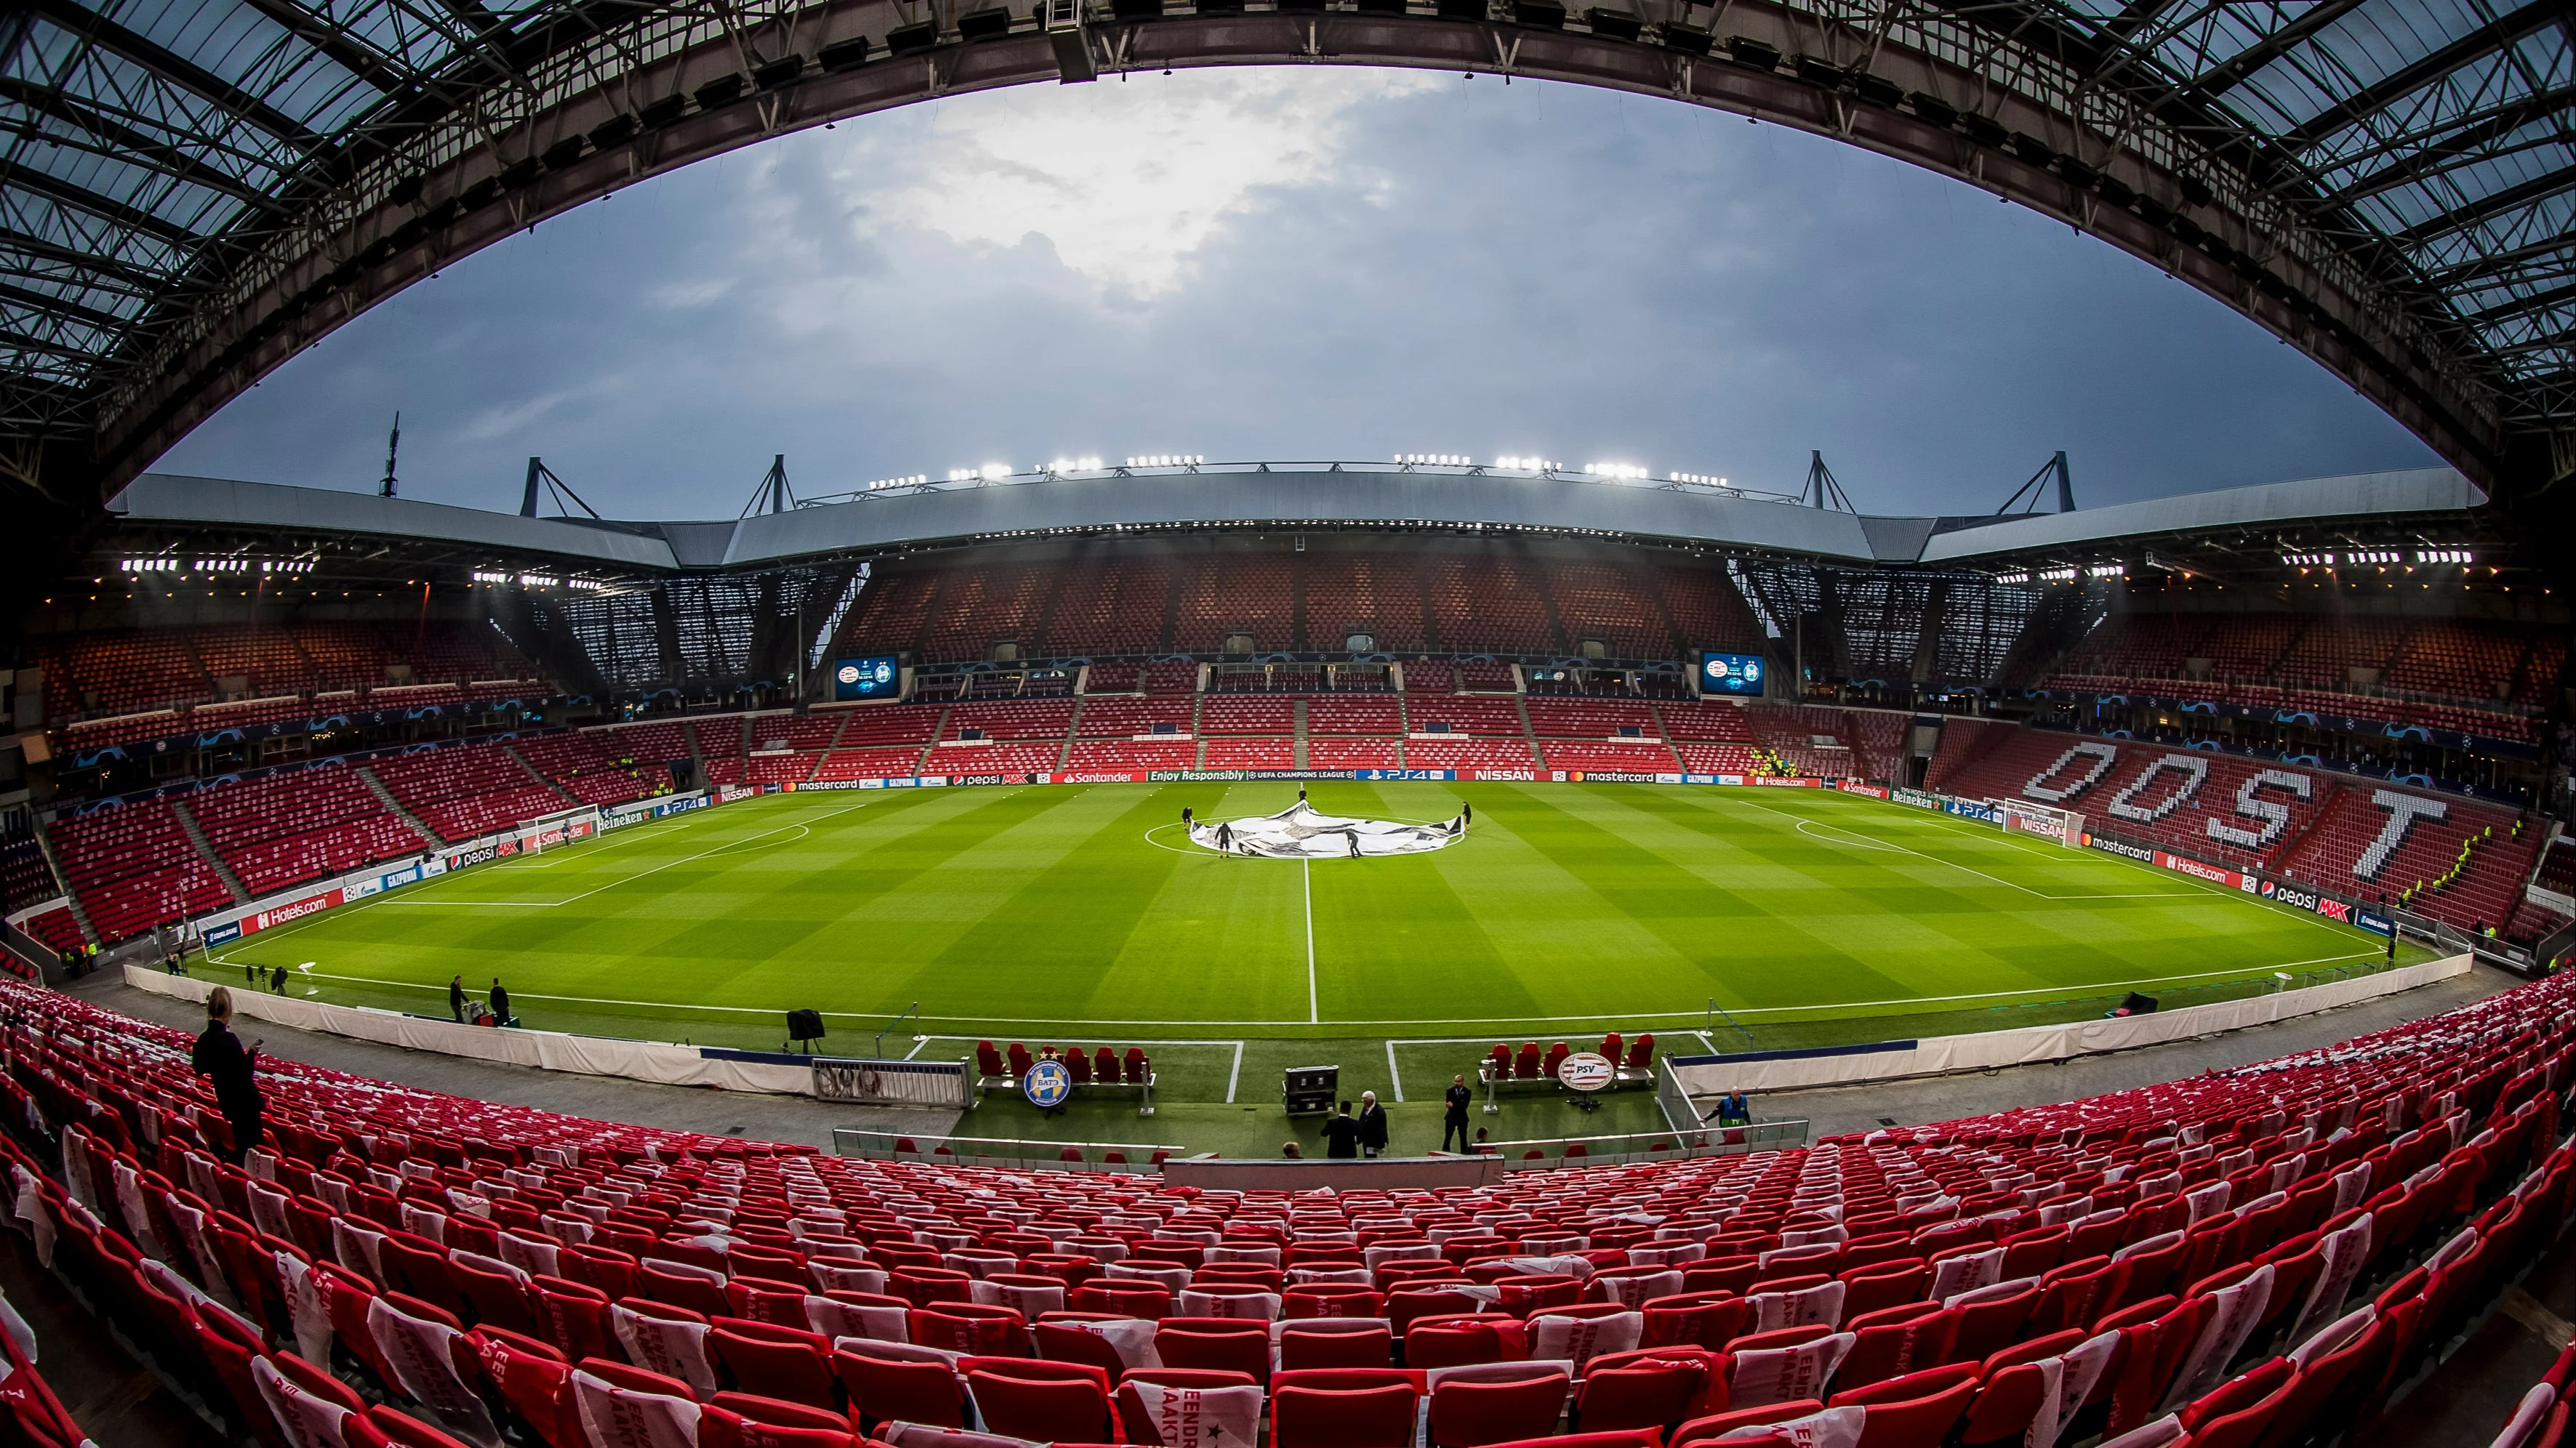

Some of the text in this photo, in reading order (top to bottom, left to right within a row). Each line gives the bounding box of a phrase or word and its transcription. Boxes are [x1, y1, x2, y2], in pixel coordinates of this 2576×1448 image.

[968, 773, 1030, 785] pepsi MAX
[1075, 773, 1132, 783] Santander
[1150, 770, 1244, 781] Enjoy Responsibly
[1387, 771, 1427, 779] PS4
[1475, 771, 1535, 781] NISSAN
[1586, 771, 1654, 781] mastercard
[1765, 776, 1805, 787] Hotels.com
[798, 779, 858, 791] mastercard
[1850, 783, 1882, 798] Santander
[721, 787, 754, 803] NISSAN
[1892, 790, 1933, 810] Heineken
[2020, 818, 2065, 840] NISSAN
[464, 840, 520, 867] pepsi MAX
[2093, 837, 2151, 861] mastercard
[388, 869, 417, 887] GAZPROM
[2178, 859, 2226, 883] Hotels.com
[271, 897, 327, 925] Hotels.com
[2276, 887, 2351, 923] pepsi MAX
[1576, 1065, 1596, 1074] PSV
